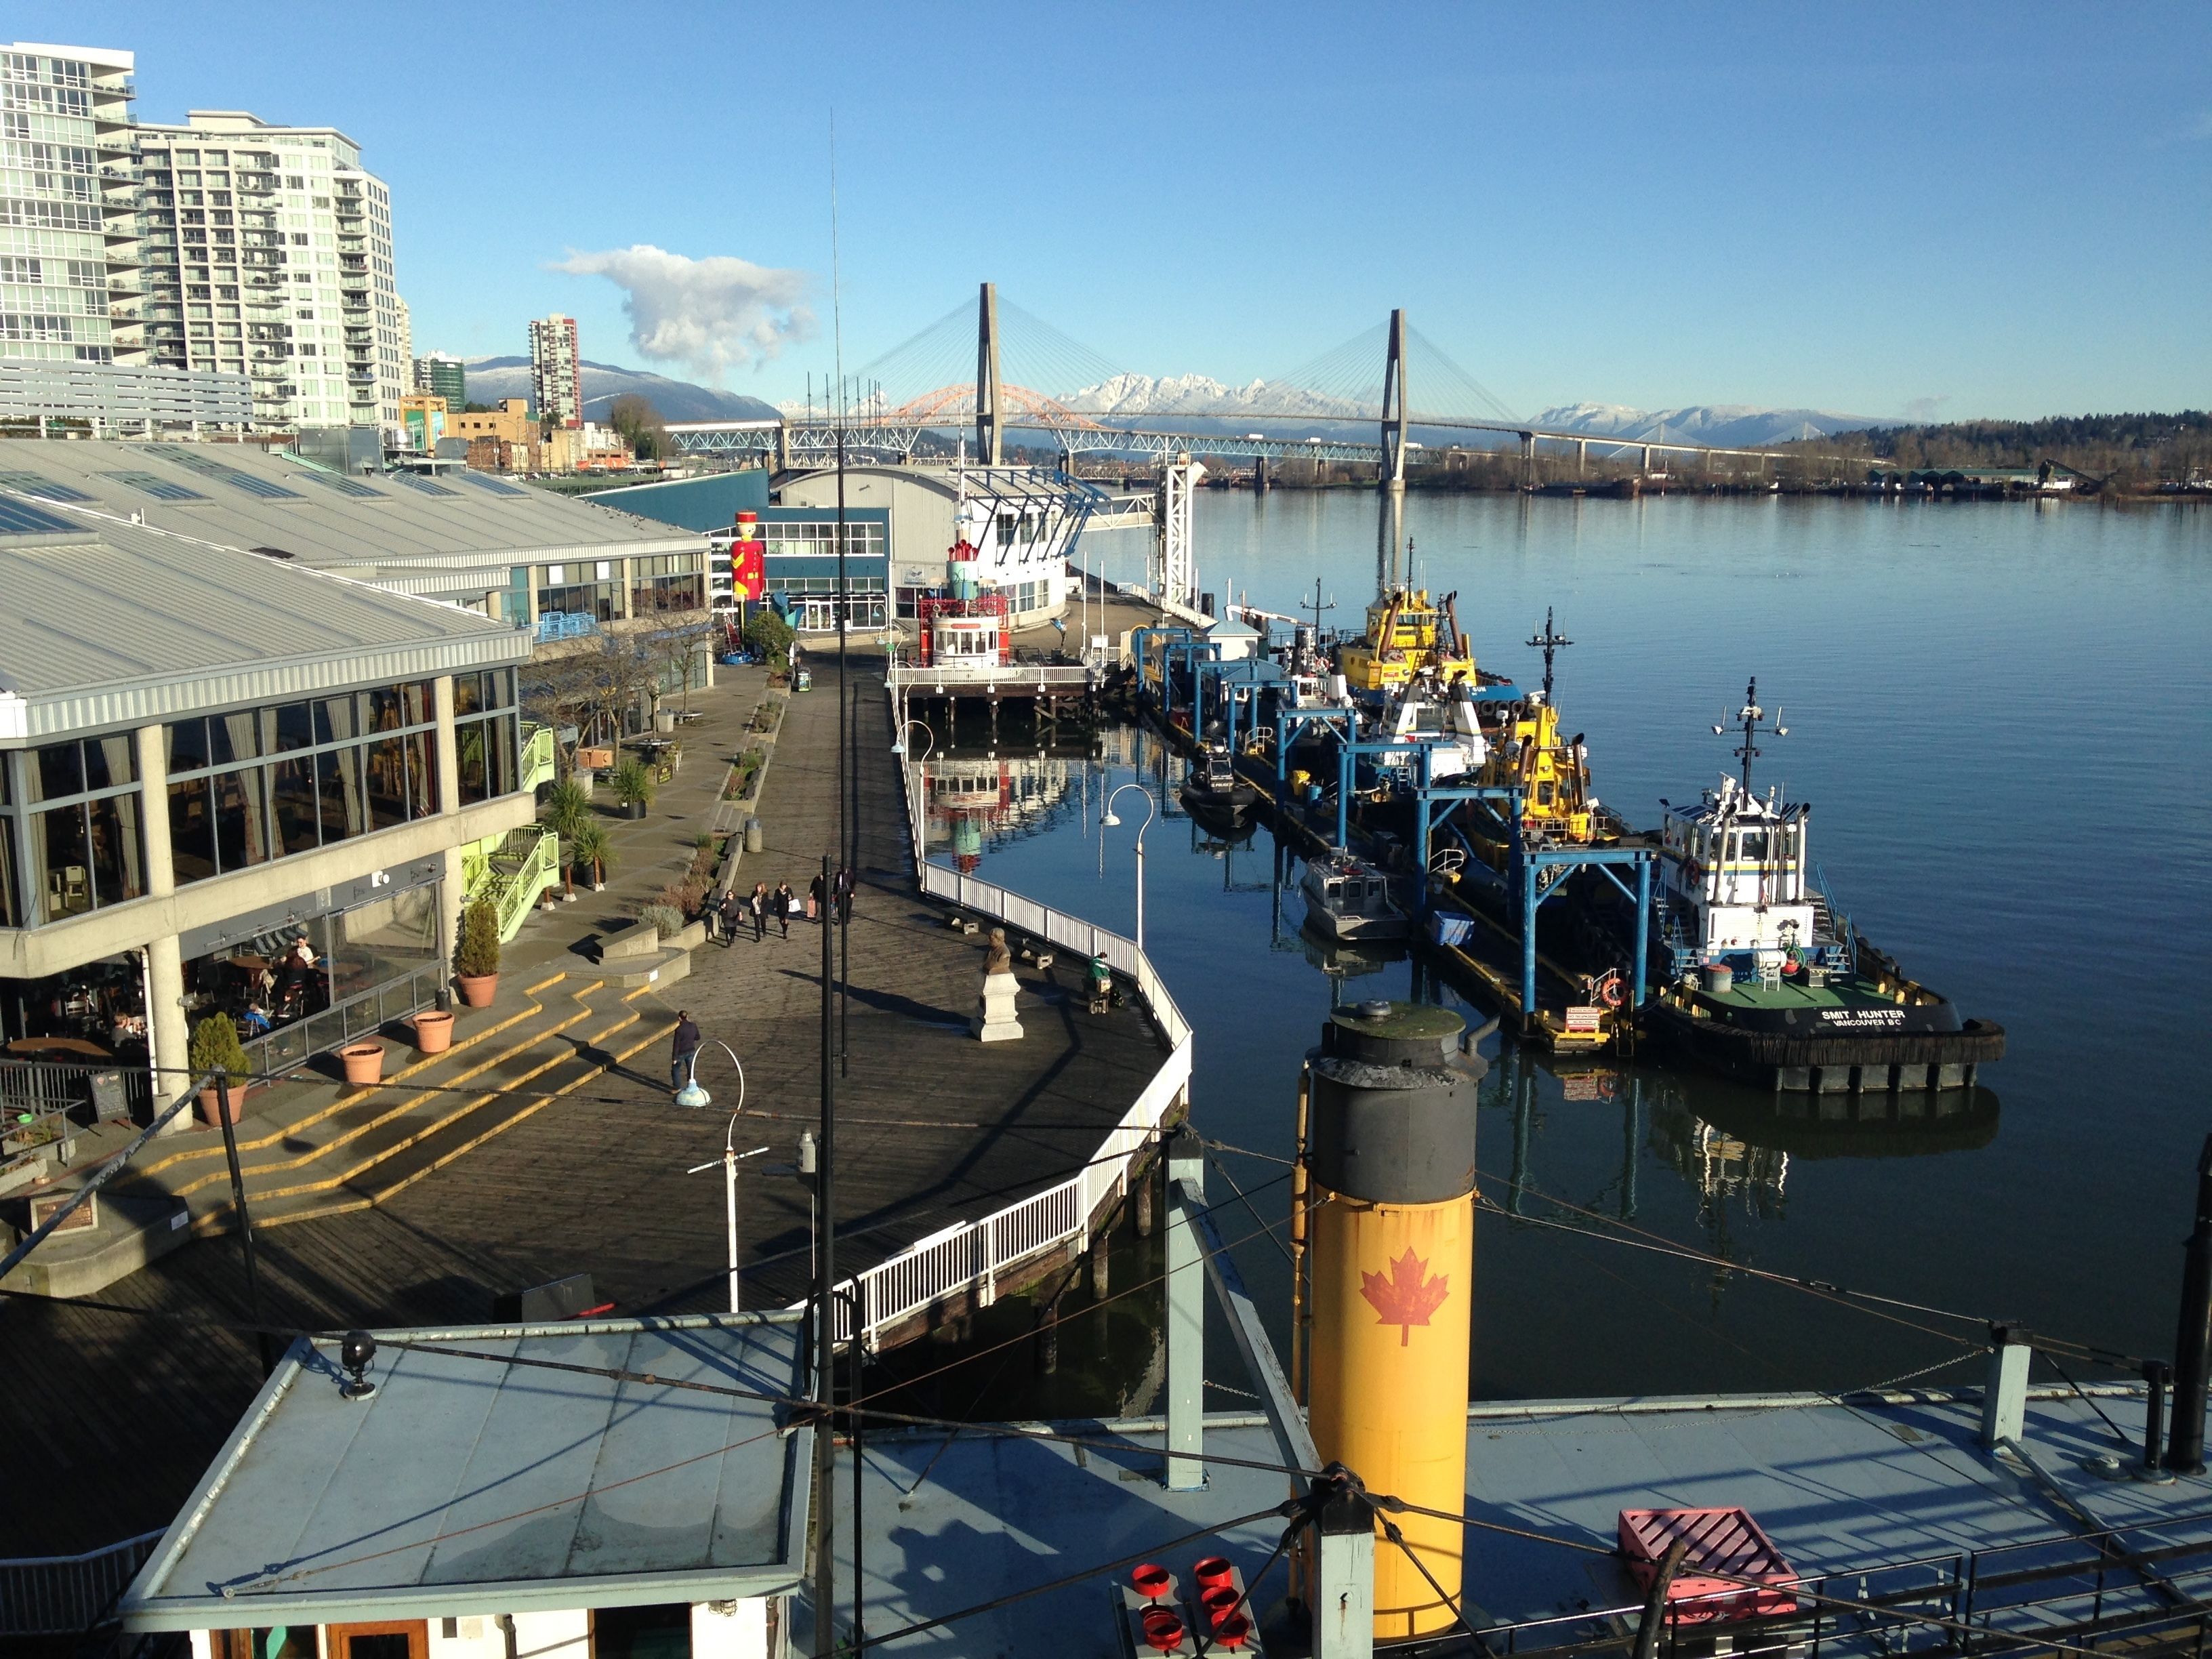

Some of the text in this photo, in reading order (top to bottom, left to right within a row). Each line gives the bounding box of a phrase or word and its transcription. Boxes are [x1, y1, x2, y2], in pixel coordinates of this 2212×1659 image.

[1822, 1010, 1906, 1020] SMIT HUNTER
[1832, 1019, 1885, 1027] VANCOUVER
